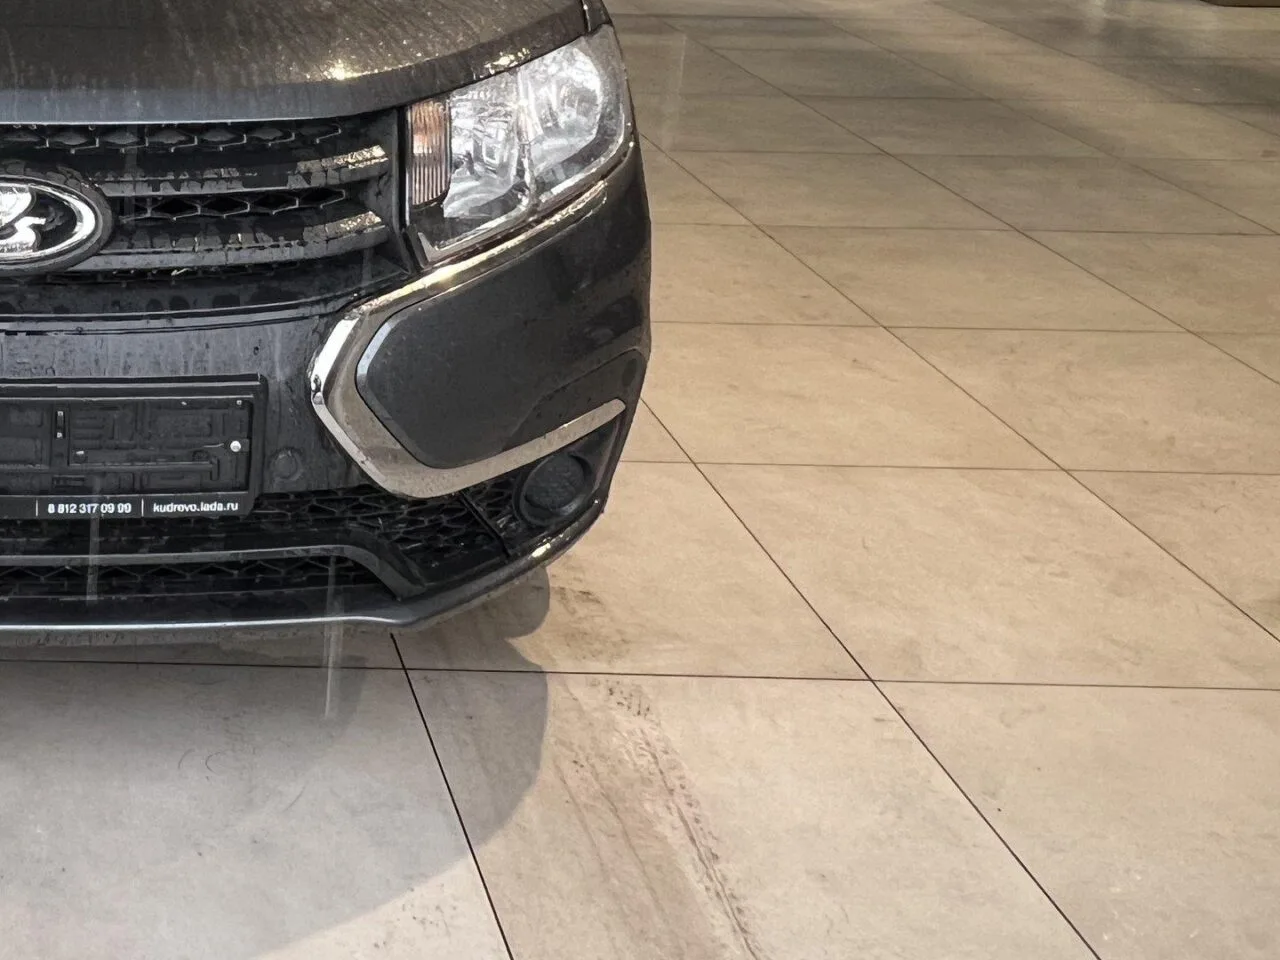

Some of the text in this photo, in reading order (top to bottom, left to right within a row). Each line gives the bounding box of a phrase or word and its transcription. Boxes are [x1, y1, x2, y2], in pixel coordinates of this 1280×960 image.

[57, 503, 78, 514] 812
[79, 502, 100, 514] 317
[153, 501, 239, 514] kudrovo.lada.ru
